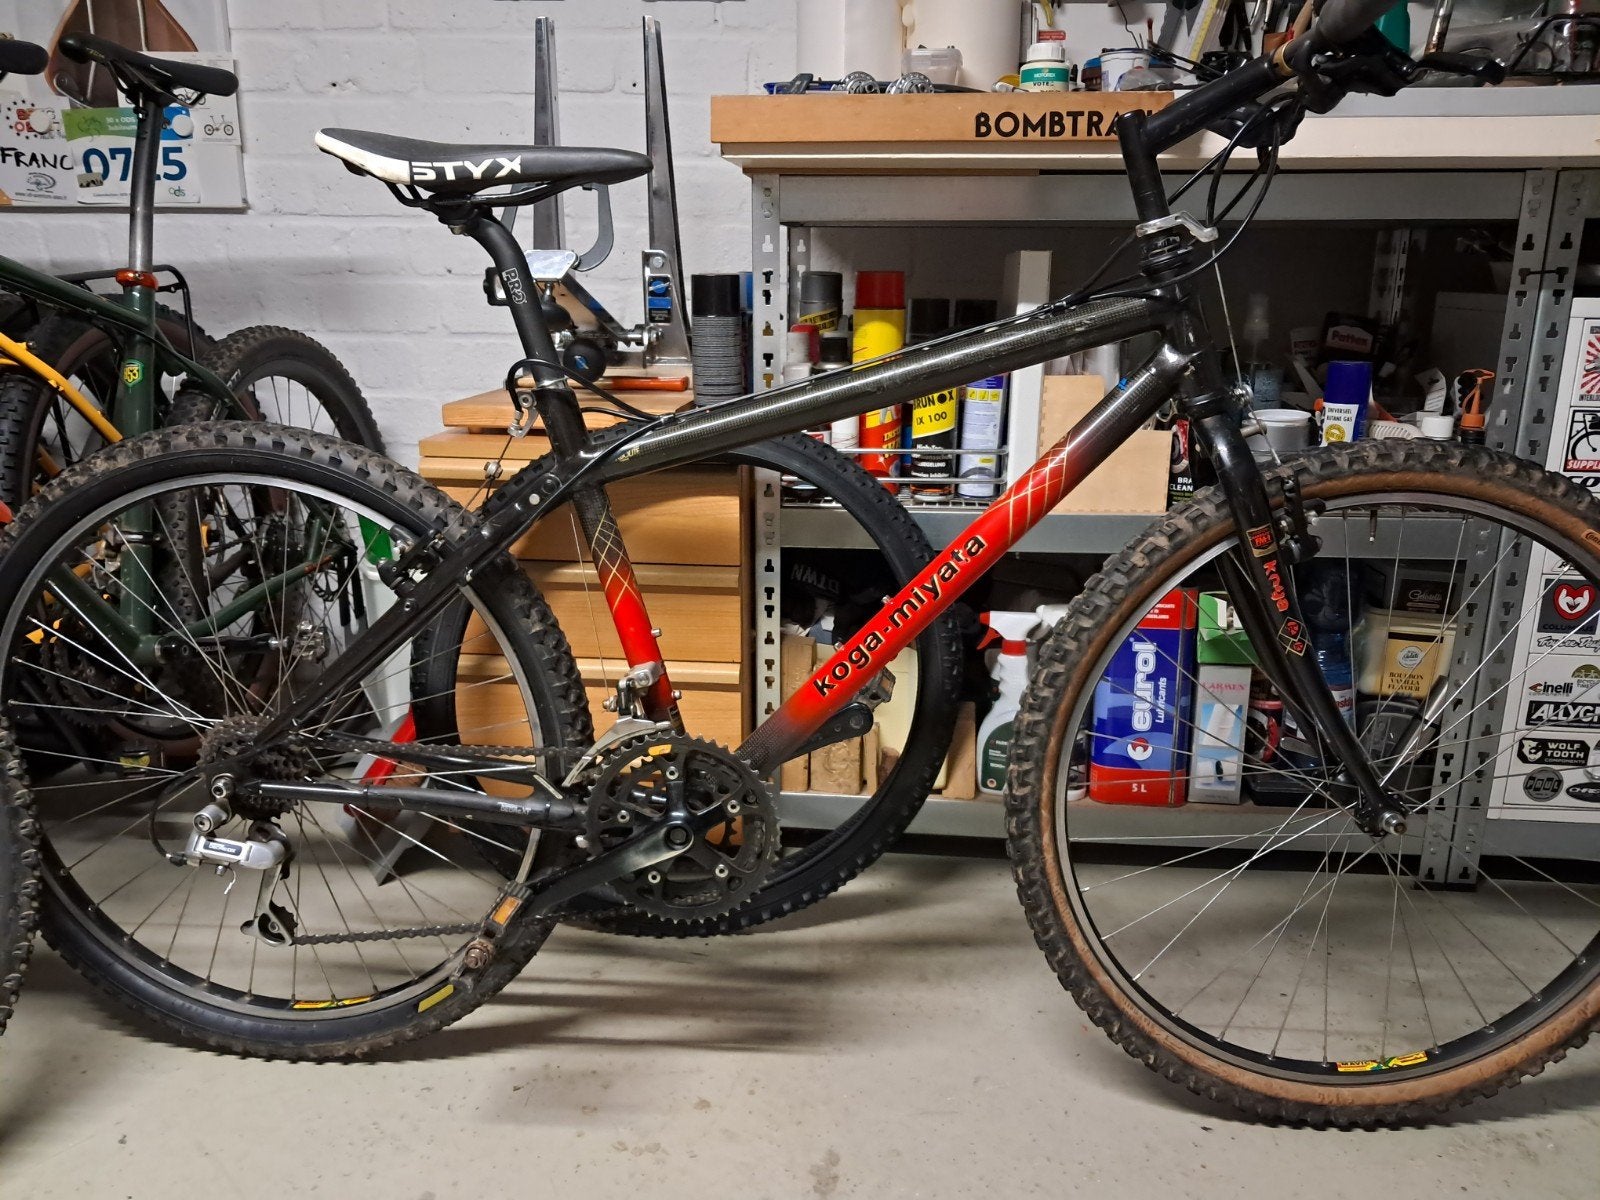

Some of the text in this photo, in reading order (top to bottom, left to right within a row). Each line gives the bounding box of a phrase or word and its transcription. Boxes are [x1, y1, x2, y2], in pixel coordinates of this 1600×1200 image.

[974, 110, 1153, 138] BOMBTRA
[82, 147, 187, 181] 075
[411, 155, 522, 182] STYX
[928, 411, 947, 423] 100
[1169, 483, 1193, 491] CLEAN
[1177, 476, 1193, 484] BRA
[812, 534, 987, 698] koga-miyata
[1131, 641, 1157, 732] eurol
[1155, 677, 1167, 723] Lubricants
[1546, 750, 1584, 758] TOOTH
[1547, 742, 1581, 750] WOLF
[1131, 783, 1147, 793] 5 L
[1525, 776, 1560, 792] PAUL
